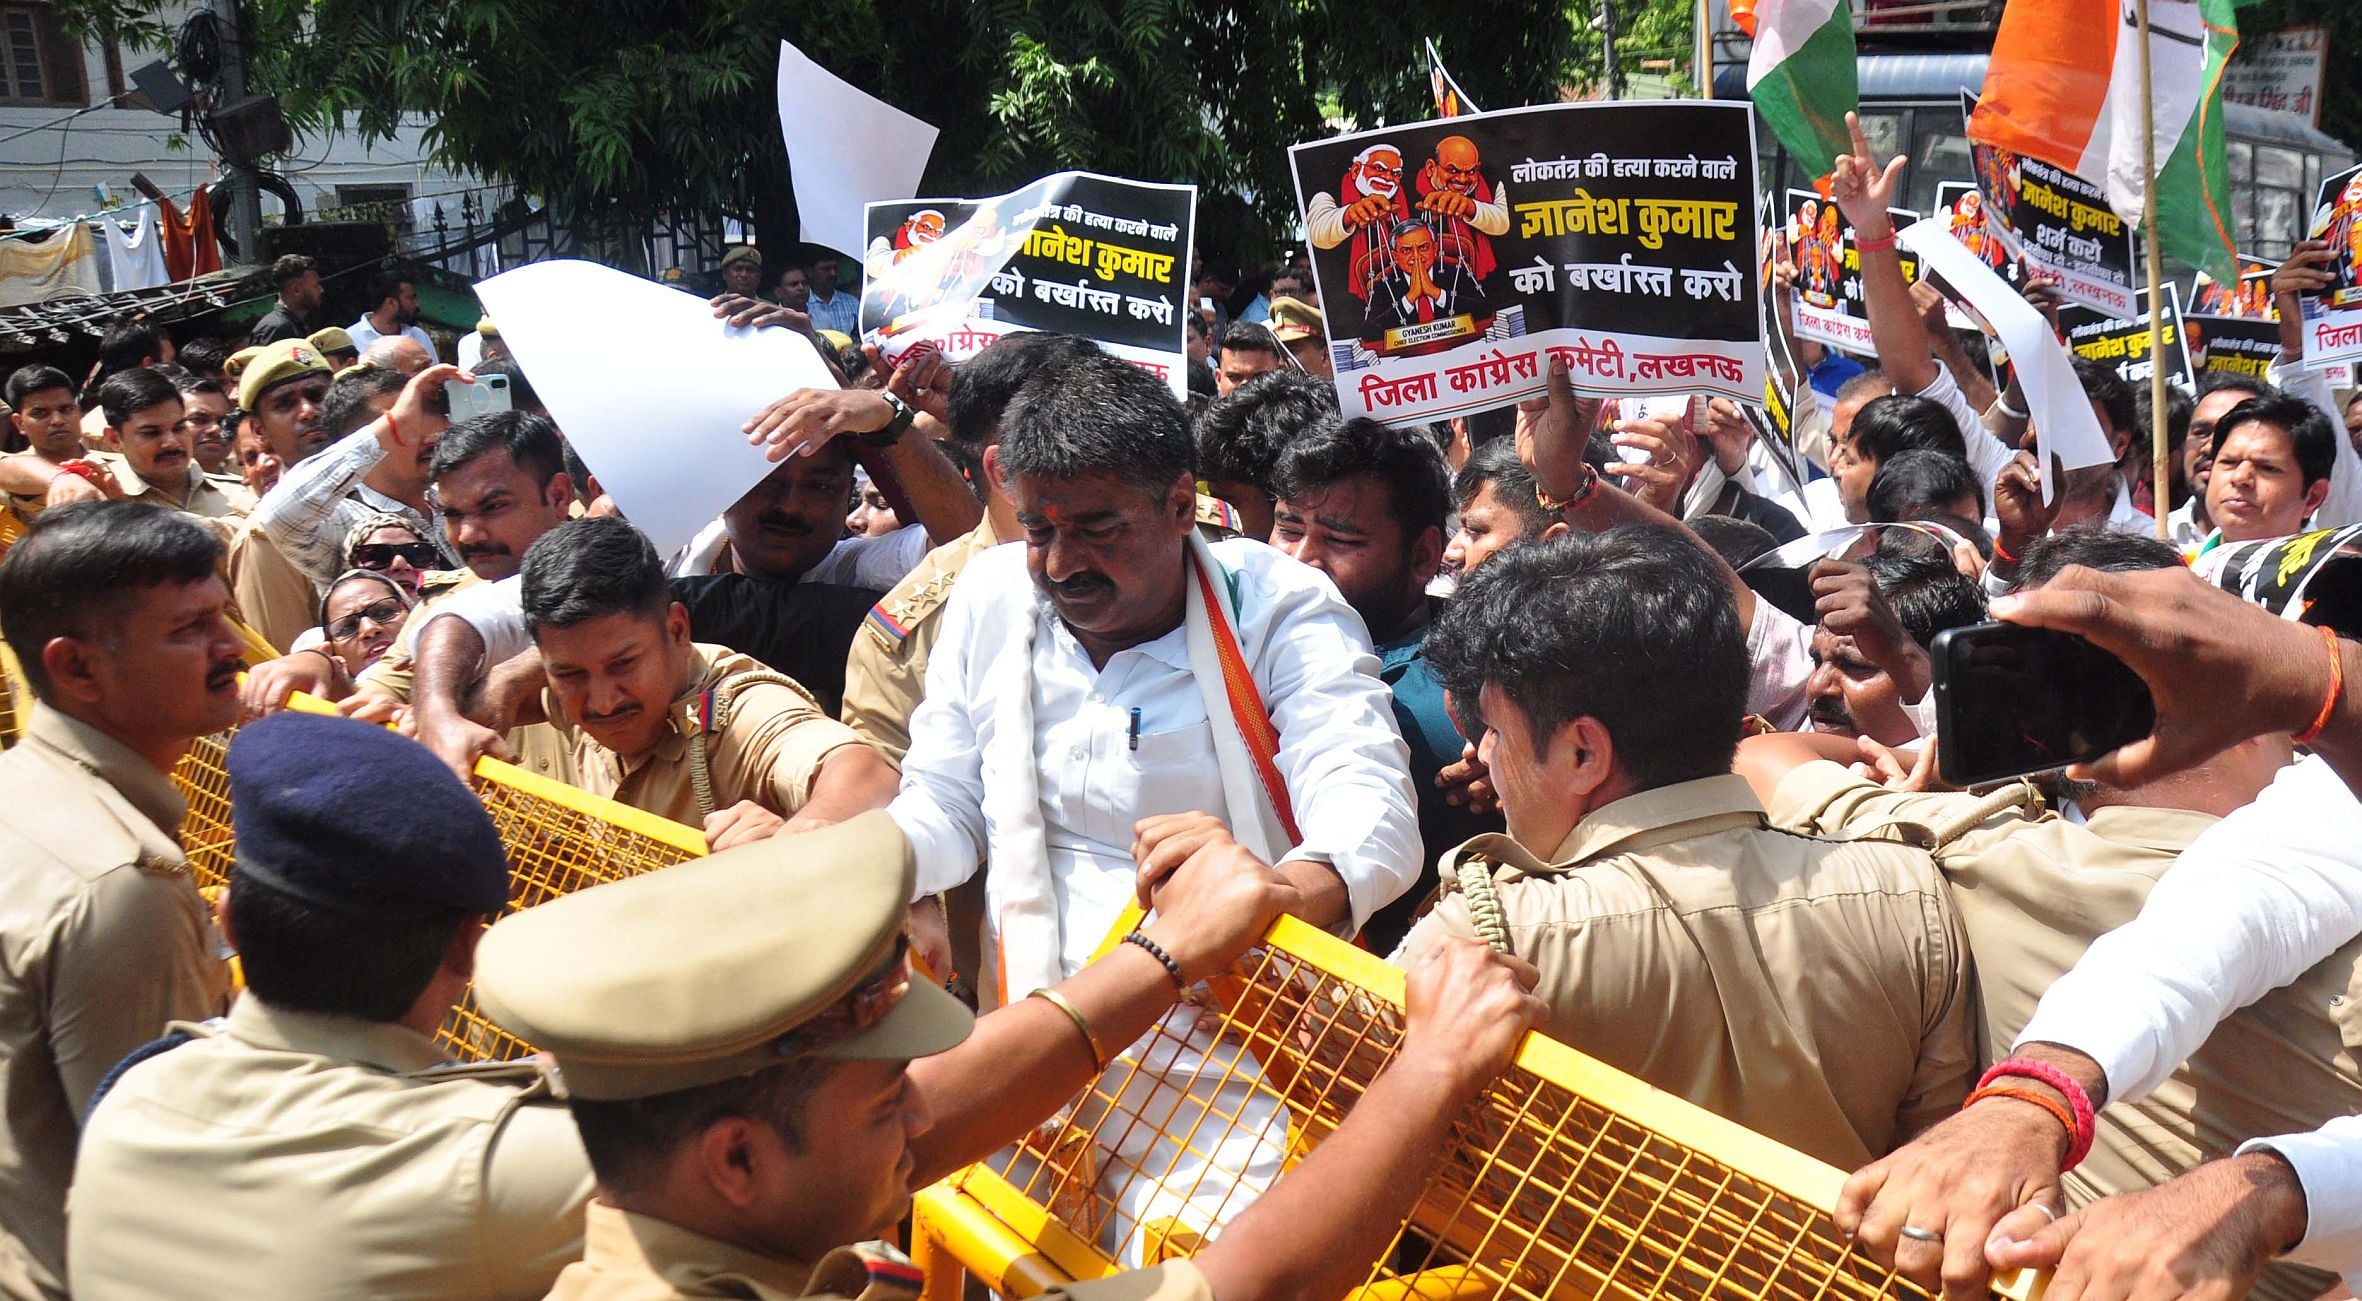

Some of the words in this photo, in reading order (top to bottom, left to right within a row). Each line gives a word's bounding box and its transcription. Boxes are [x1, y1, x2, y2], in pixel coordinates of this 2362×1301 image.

[1510, 154, 1581, 183] लोकतंत्र
[1583, 152, 1610, 178] की
[1611, 158, 1652, 178] हत्या
[1653, 154, 1700, 180] करने
[1701, 154, 1739, 181] वाले
[1063, 204, 1085, 224] की
[1084, 212, 1115, 231] हत्या
[1114, 218, 1150, 238] करने
[1149, 222, 1179, 243] वाले
[1514, 187, 1631, 239] ज्ञानेश
[1634, 198, 1739, 250] कुमार
[2021, 179, 2070, 219] ज्ञानेश
[2070, 200, 2121, 236] कुमार
[1094, 241, 1175, 283] कुमार
[2036, 223, 2067, 251] शर्म
[2068, 235, 2104, 263] करो
[990, 266, 1026, 298] को
[1032, 279, 1121, 315] बर्खास्त
[1126, 294, 1175, 326] करो
[1508, 254, 1555, 295] को
[1564, 252, 1674, 298] बर्खास्त
[1680, 259, 1744, 302] करो
[1402, 326, 1432, 338] GYANESH
[1433, 320, 1457, 333] KUMAR
[1358, 373, 1438, 412] जिला
[1444, 348, 1538, 394] कांग्रेस
